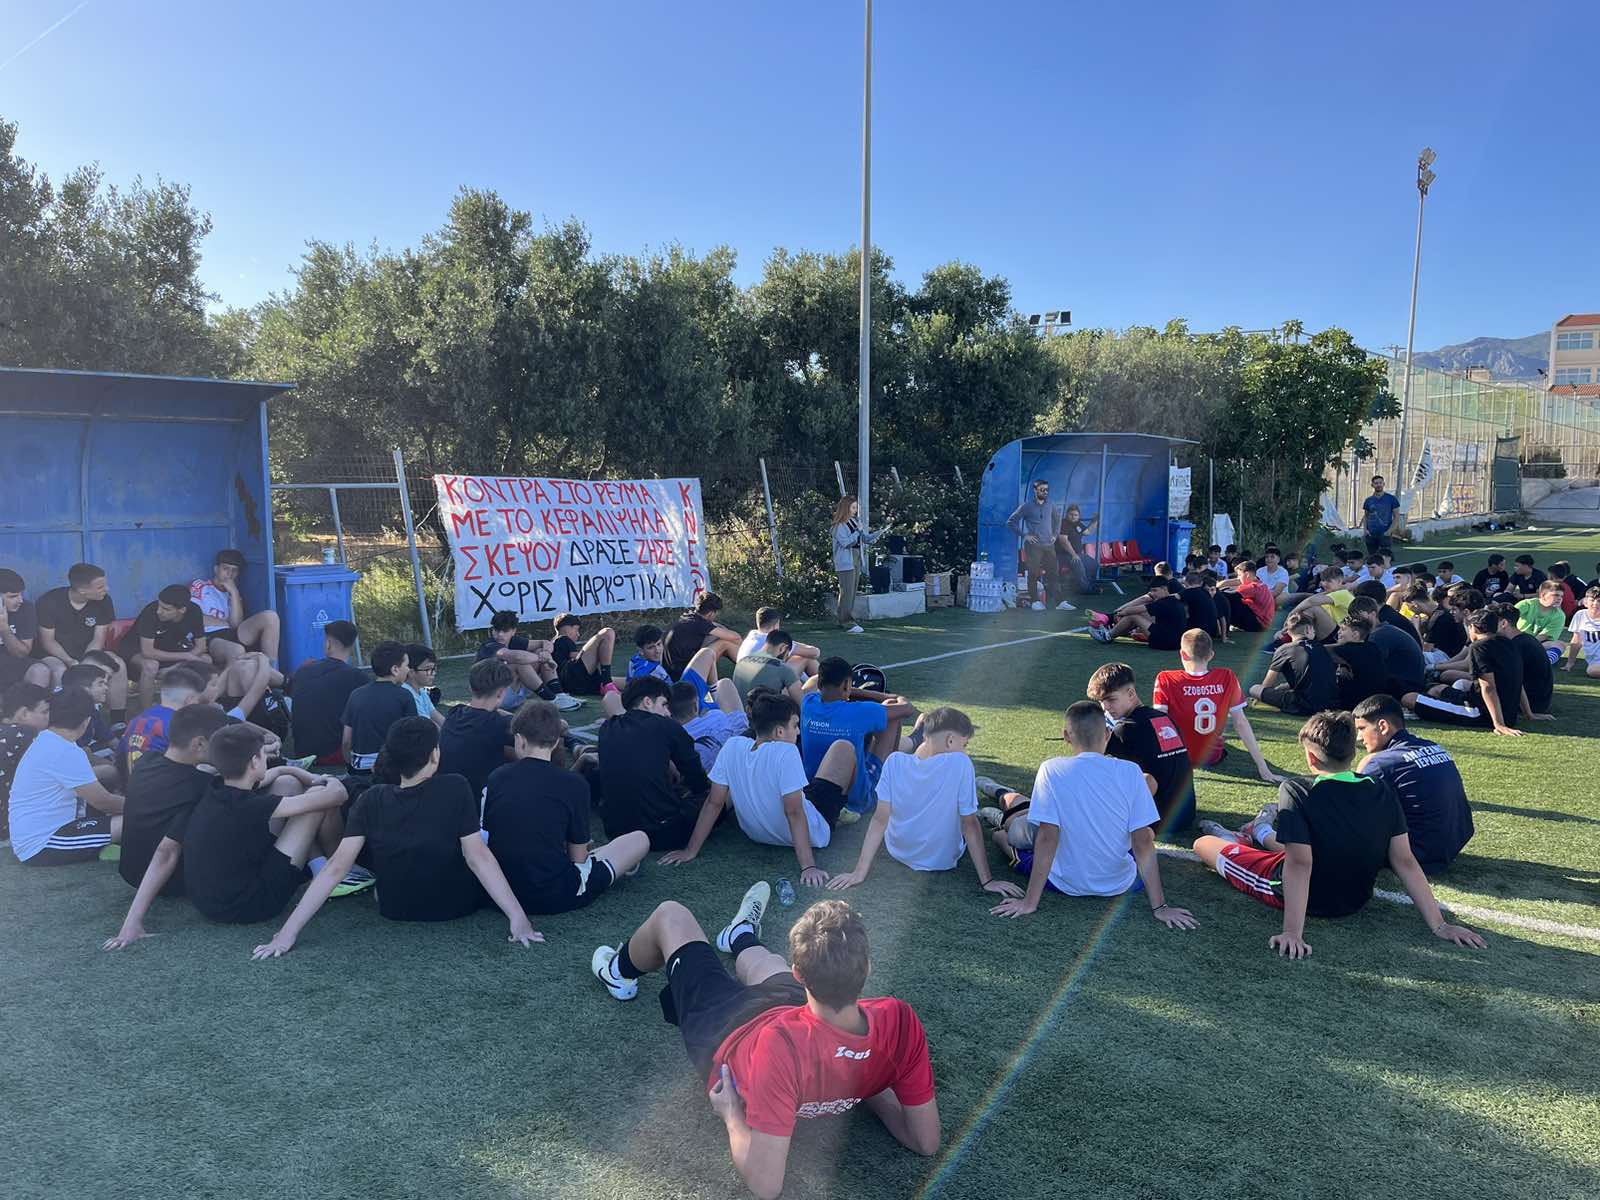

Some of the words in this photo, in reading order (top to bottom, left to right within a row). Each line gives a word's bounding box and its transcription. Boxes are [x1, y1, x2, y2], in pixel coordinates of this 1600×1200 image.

[442, 476, 551, 505] ΚΟΝΤΡΑ
[592, 482, 656, 505] ΡΕΥΜΑ
[451, 509, 492, 538] ΜΕ
[496, 509, 534, 534] ΤΟ
[459, 541, 561, 580] ΣΚΕΨΟΥ
[570, 539, 634, 566] ΔΡΑΣΕ
[634, 539, 675, 566] ΖΗΣΕ
[1194, 697, 1217, 735] 8
